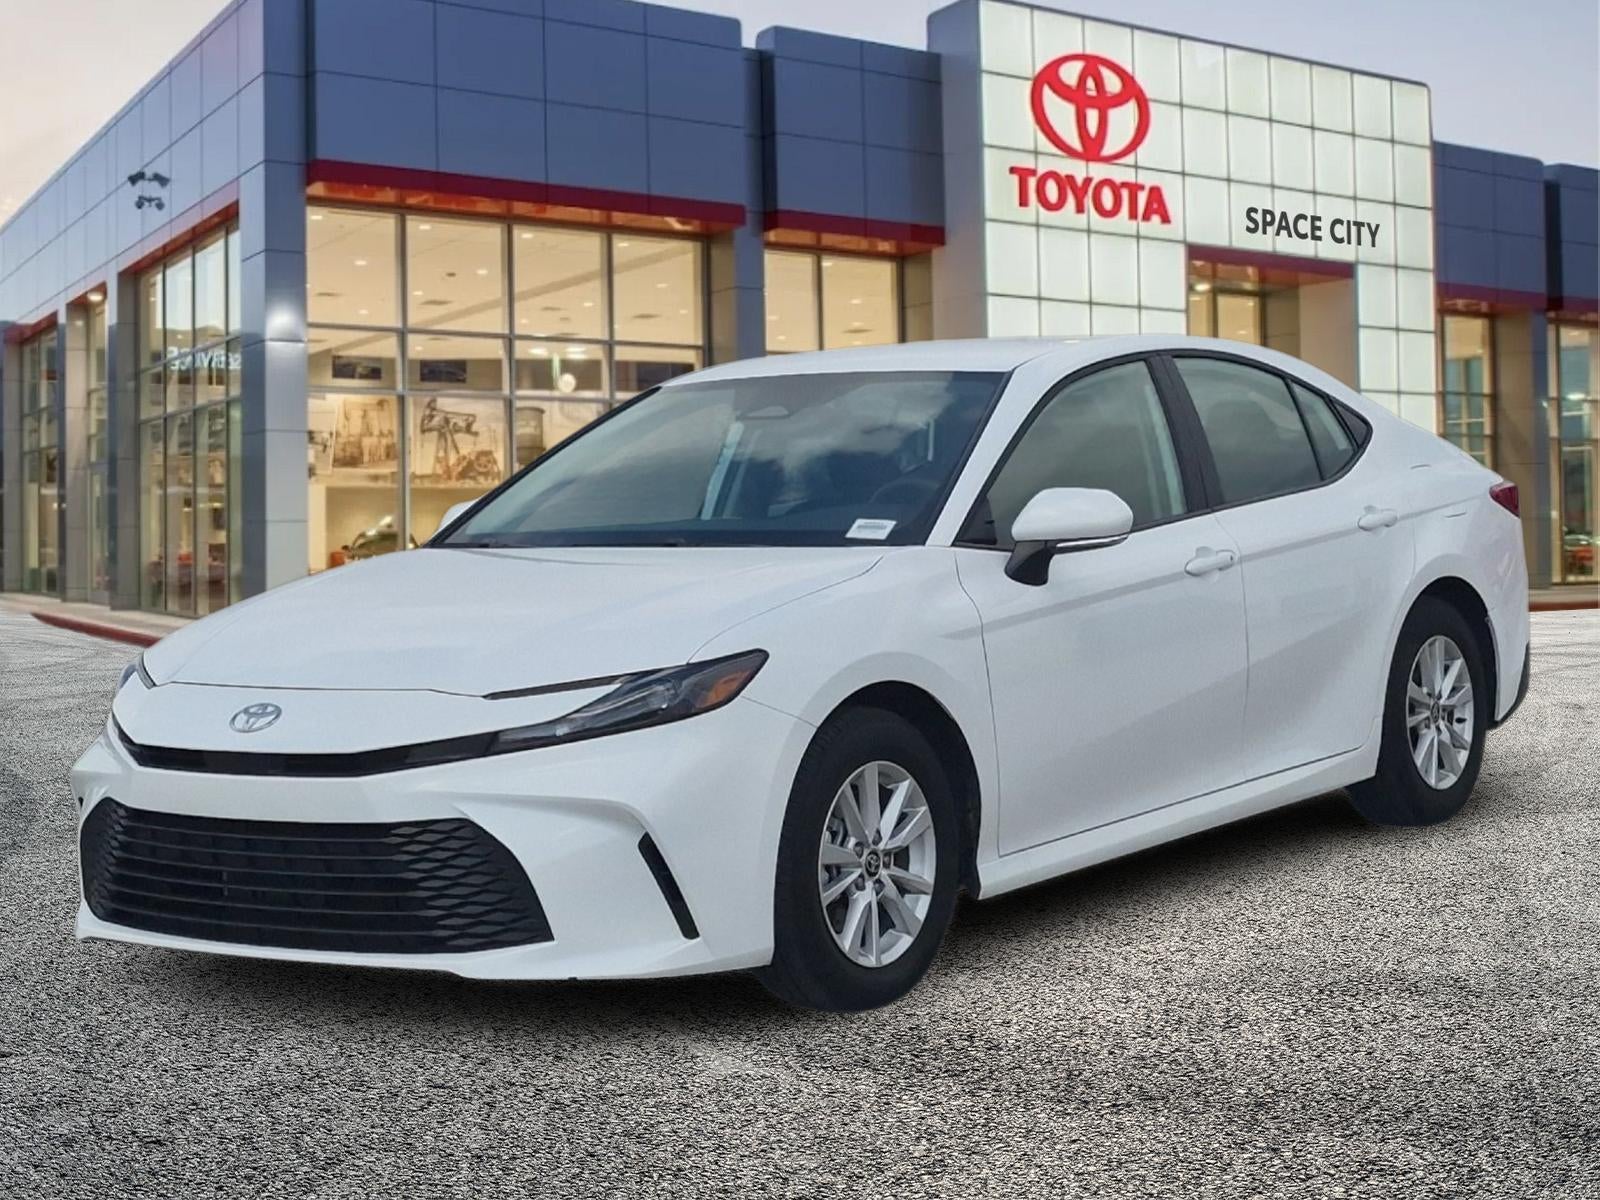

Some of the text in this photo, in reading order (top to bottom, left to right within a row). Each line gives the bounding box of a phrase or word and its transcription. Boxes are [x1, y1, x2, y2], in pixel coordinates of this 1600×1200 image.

[1009, 166, 1171, 224] TOYOTA
[1245, 206, 1381, 248] SPACE CITY
